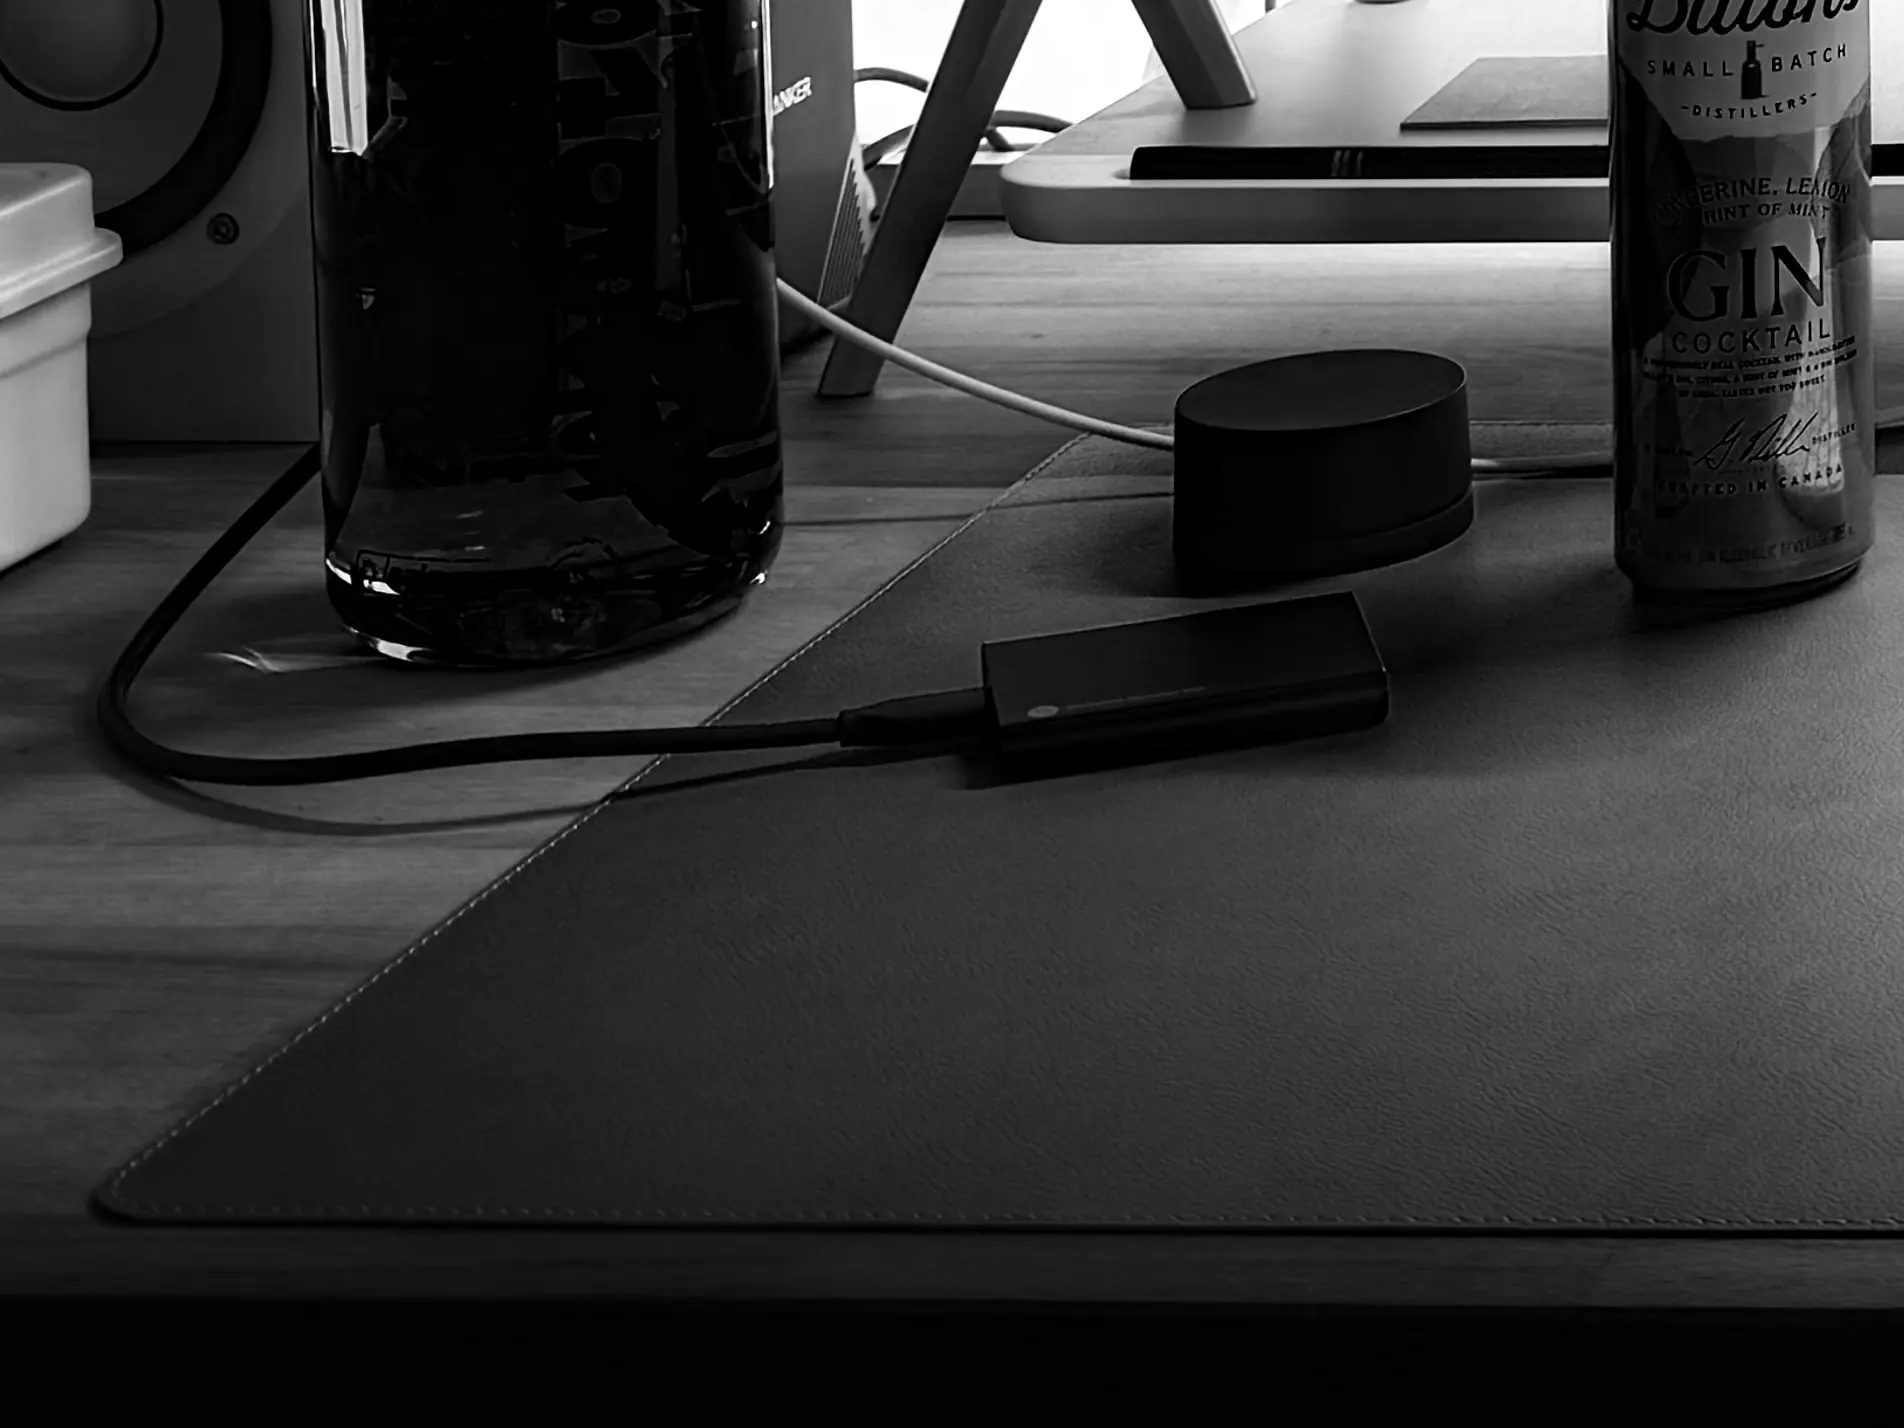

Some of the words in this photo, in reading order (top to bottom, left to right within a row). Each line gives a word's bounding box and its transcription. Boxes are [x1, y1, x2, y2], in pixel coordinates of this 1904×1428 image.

[1646, 59, 1734, 78] SMALL
[1771, 43, 1847, 74] BATCH
[1758, 202, 1782, 217] OF
[1666, 236, 1827, 323] GIN
[1671, 317, 1831, 354] COCKTAIL
[1748, 480, 1767, 492] IN
[1778, 465, 1843, 489] CANADA
